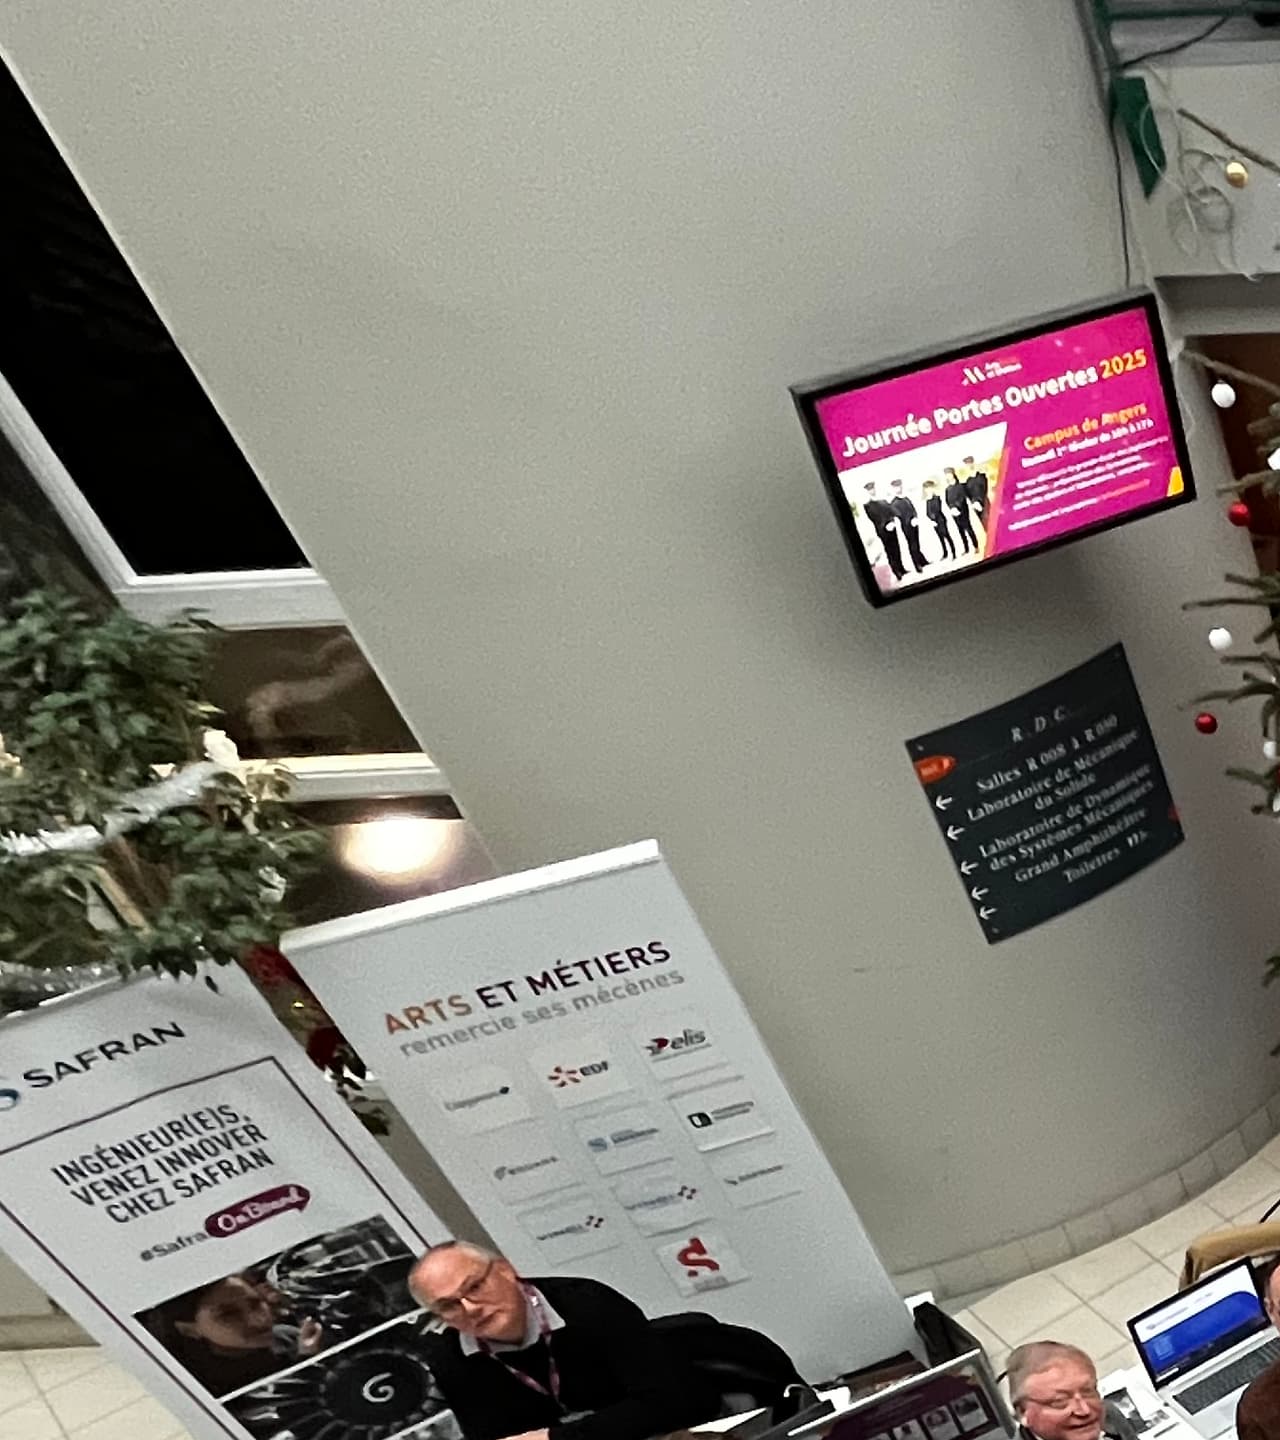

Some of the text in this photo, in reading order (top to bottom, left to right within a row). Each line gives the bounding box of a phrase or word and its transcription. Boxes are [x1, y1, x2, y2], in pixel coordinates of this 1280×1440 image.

[843, 414, 932, 459] Journée
[933, 397, 1004, 429] Portes
[1004, 365, 1099, 408] Ouvertes
[1100, 349, 1147, 379] 2025
[1024, 403, 1147, 450] Campus de Angers
[967, 776, 1052, 821] Laboratoire
[1055, 767, 1072, 783] de
[976, 767, 1022, 792] Salles
[979, 813, 1064, 858] Laboratoire
[1066, 803, 1083, 819] de
[989, 854, 1017, 871] des
[1014, 852, 1060, 882] Grand
[384, 940, 672, 1036] ARTS ET MÉTIERS
[399, 967, 685, 1057] remercie ses mécènes
[22, 1021, 186, 1088] SAFRAN
[670, 1028, 707, 1050] elis
[70, 1123, 267, 1206] VENEZ INNOVER
[105, 1147, 274, 1224] CHEZ SAFRAN
